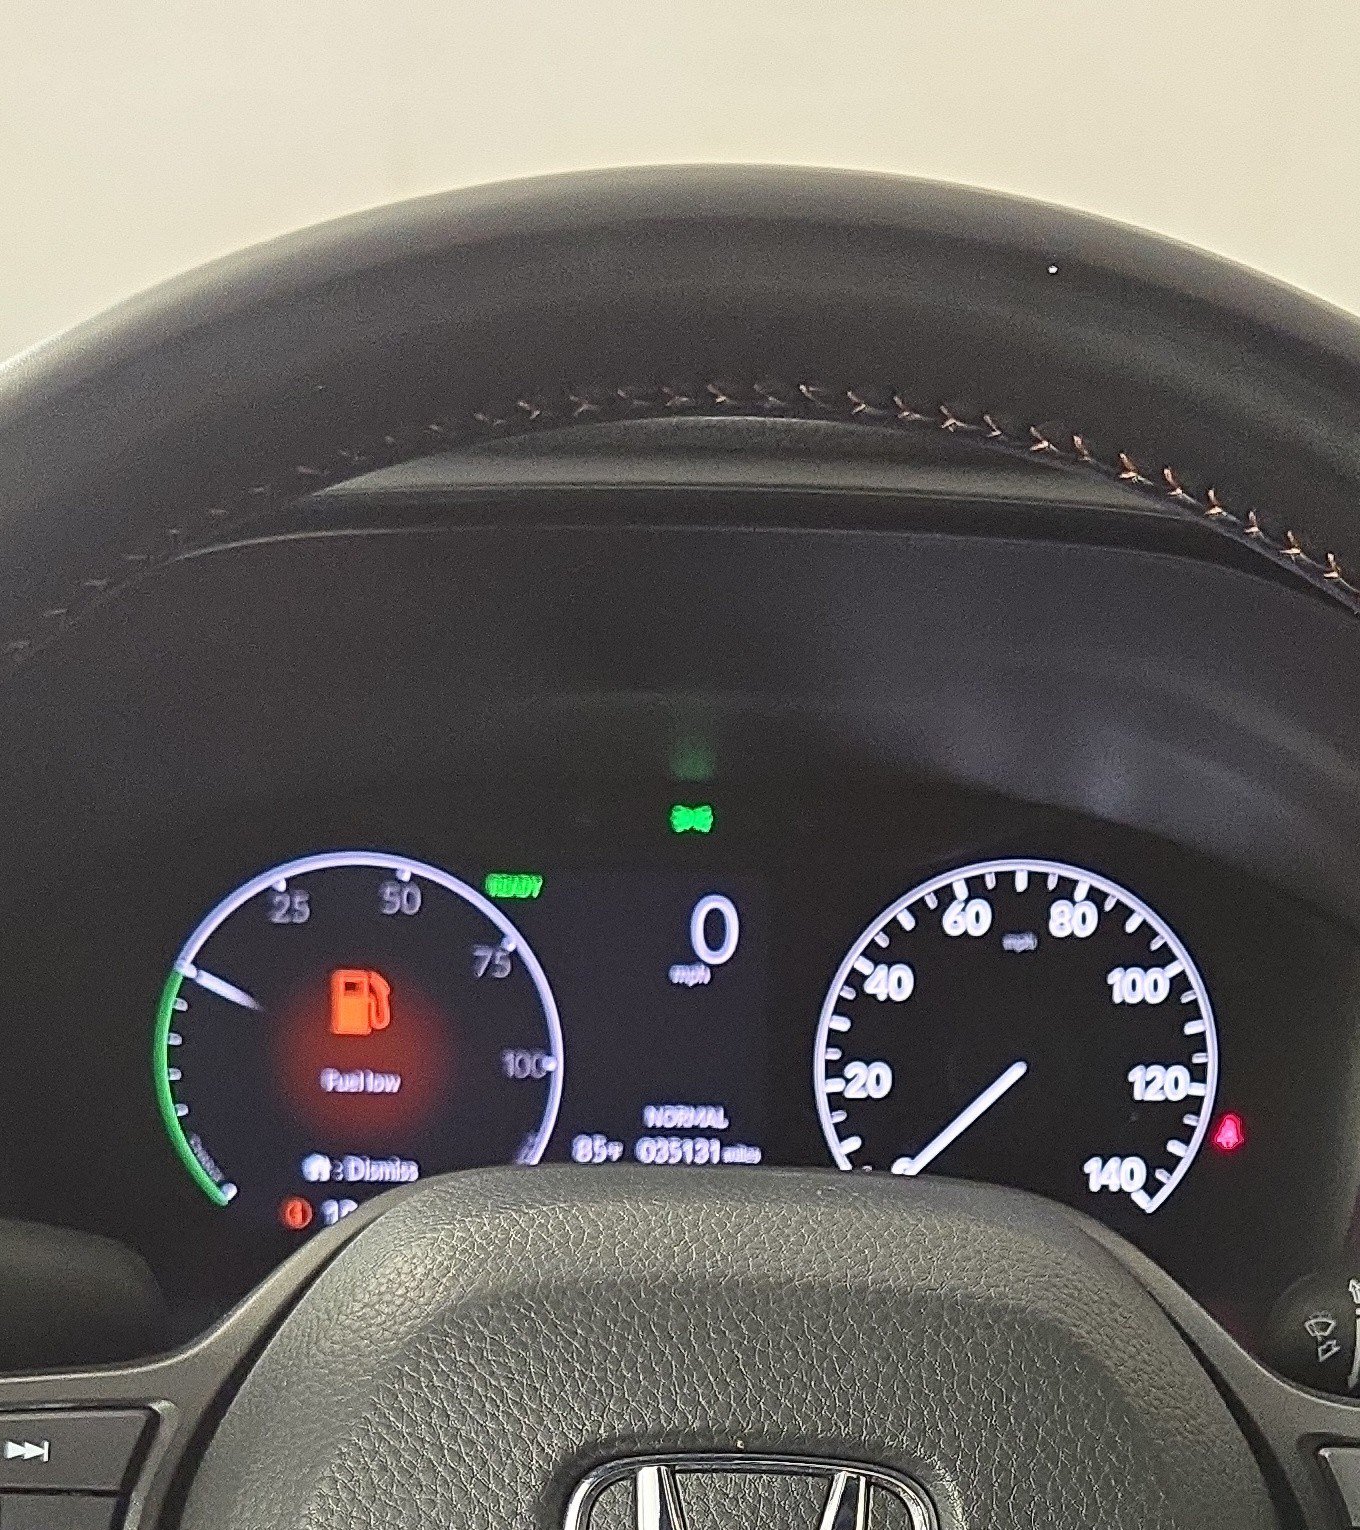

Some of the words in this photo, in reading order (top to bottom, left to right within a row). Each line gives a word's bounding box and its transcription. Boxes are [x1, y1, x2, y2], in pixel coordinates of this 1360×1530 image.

[270, 889, 310, 924] 25
[379, 883, 421, 916] 50
[942, 899, 992, 937] 60
[691, 894, 739, 965] 0
[1049, 899, 1098, 938] 80
[473, 946, 511, 979] 75
[864, 964, 914, 1002] 40
[1107, 967, 1170, 1004] 100
[502, 1050, 548, 1078] 100
[843, 1062, 893, 1099] 20
[1128, 1065, 1190, 1101] 120
[644, 1105, 729, 1129] NORMAL
[1084, 1156, 1146, 1193] 140
